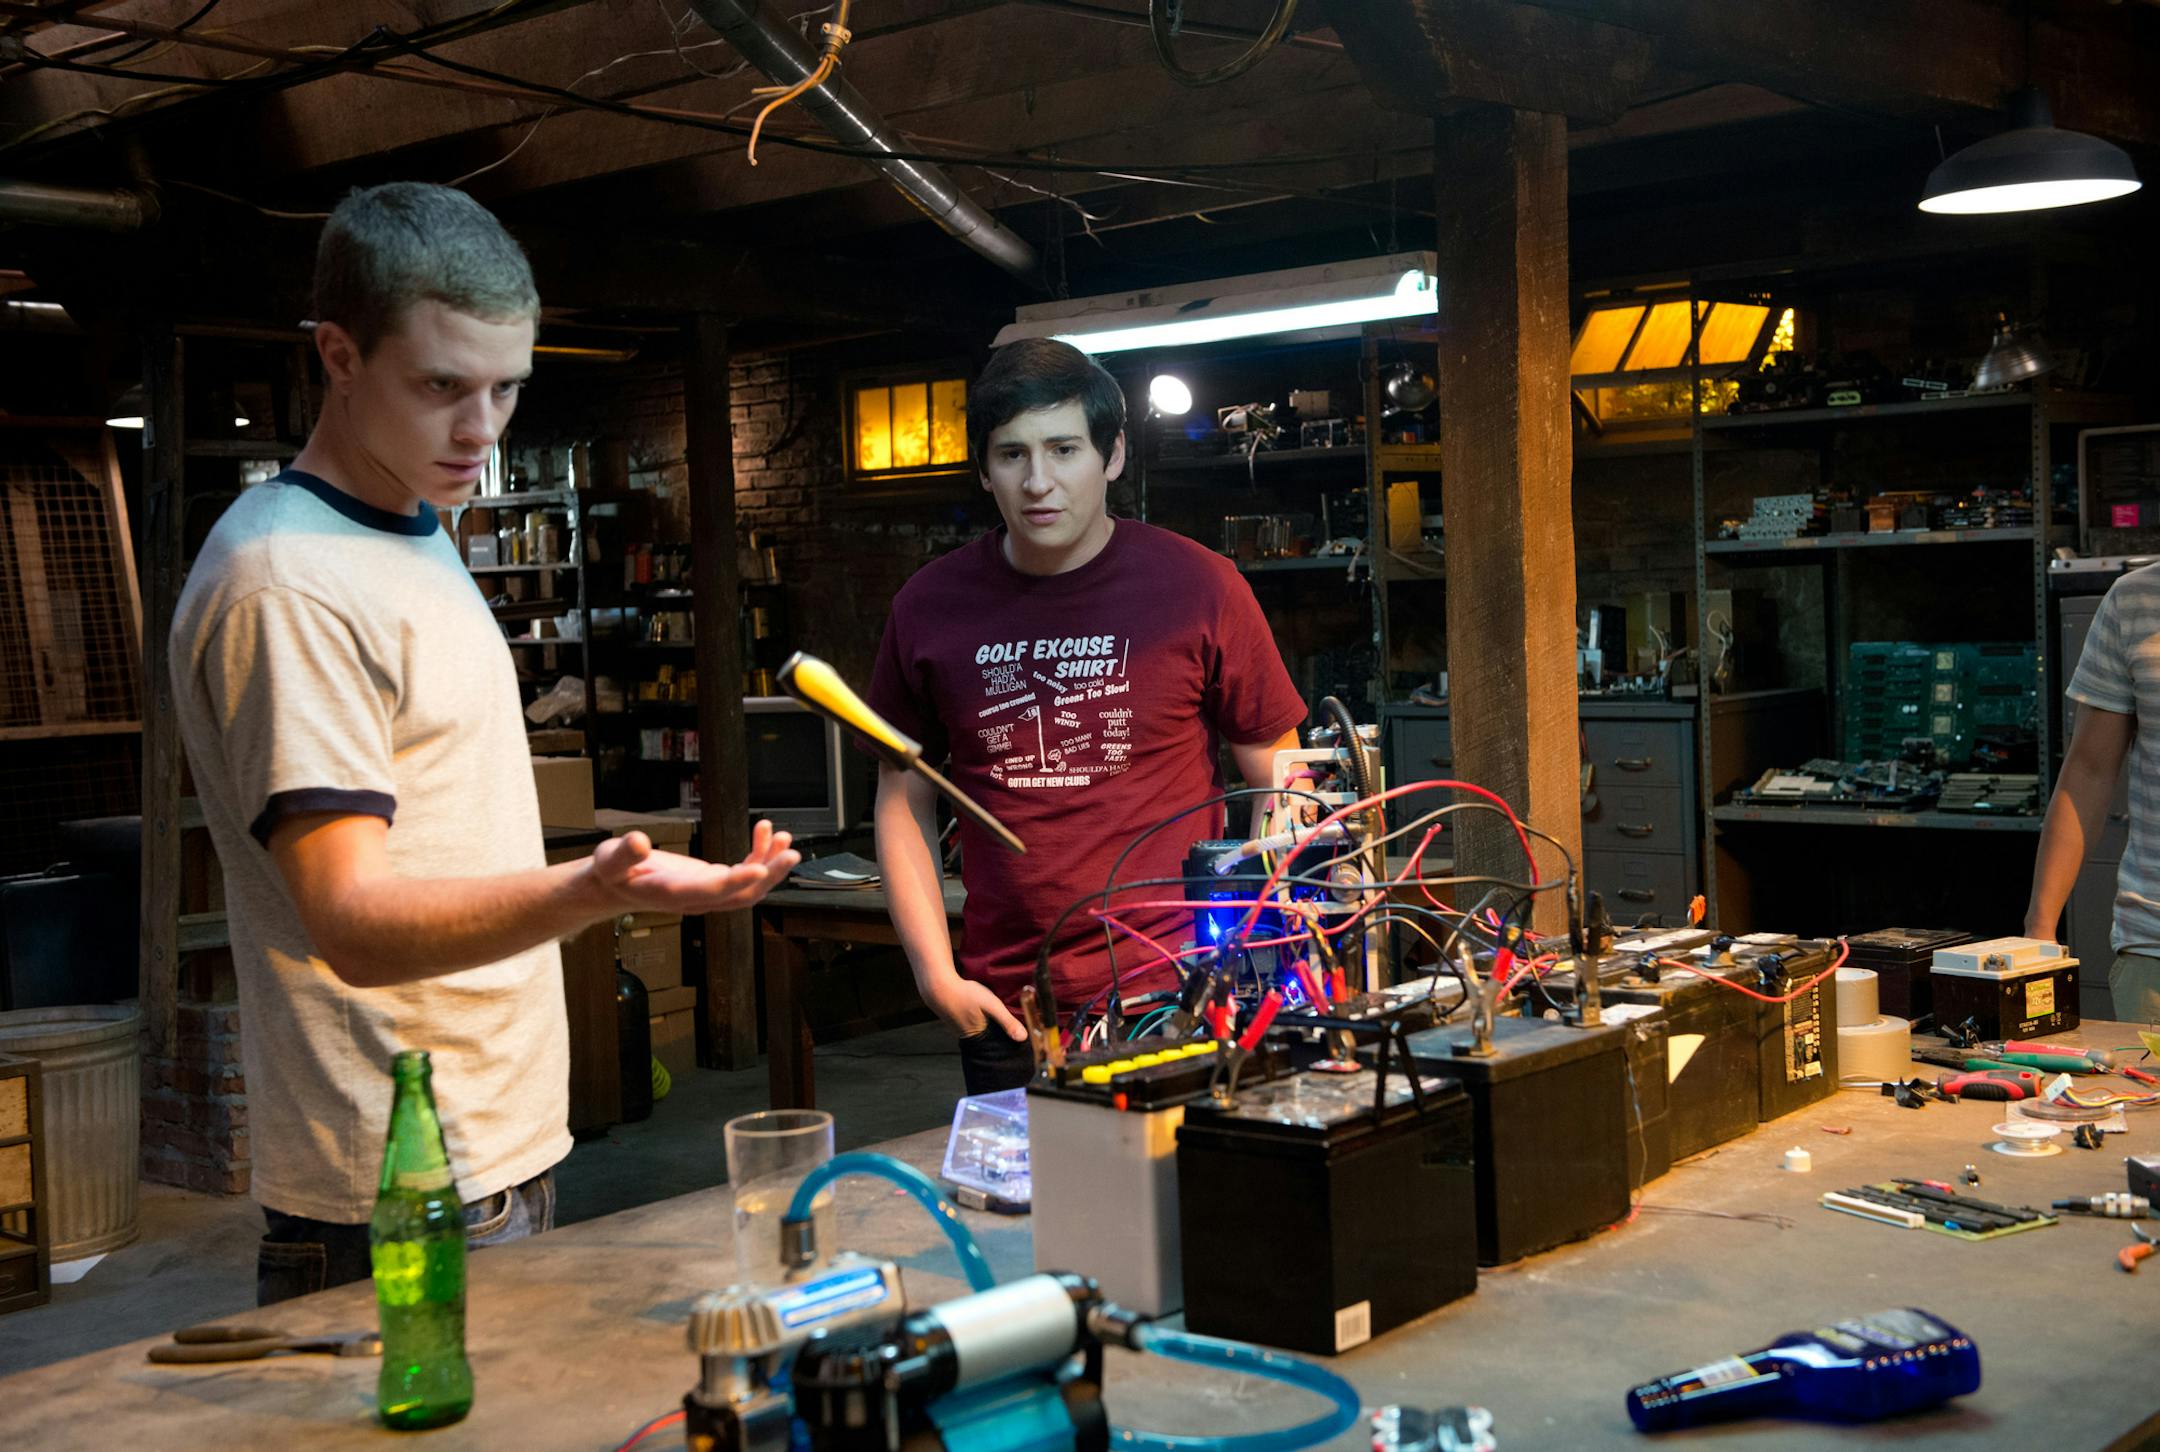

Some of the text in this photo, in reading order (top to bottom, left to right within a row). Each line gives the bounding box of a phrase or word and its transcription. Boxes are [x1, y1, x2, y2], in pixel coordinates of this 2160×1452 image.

[975, 635, 1115, 665] GOLF EXCUSE
[1055, 659, 1118, 678] SHIRT
[985, 680, 1027, 696] MULLIGAN
[1033, 671, 1068, 694] too noisy
[1088, 678, 1104, 688] cold
[1054, 681, 1130, 707] Greens Too Slow!
[1061, 711, 1077, 719] TOO
[1099, 708, 1133, 719] couldn't
[1054, 717, 1080, 728] WINDY
[1108, 718, 1127, 729] putt
[987, 733, 1008, 744] GET A
[1103, 727, 1130, 740] today!
[1061, 733, 1092, 747] TOO MANY
[1064, 746, 1077, 755] BAD
[1005, 754, 1035, 764] LINED UP
[1006, 762, 1033, 771] WRONG
[1008, 775, 1090, 788] GOTTA GET NEW CLUBS
